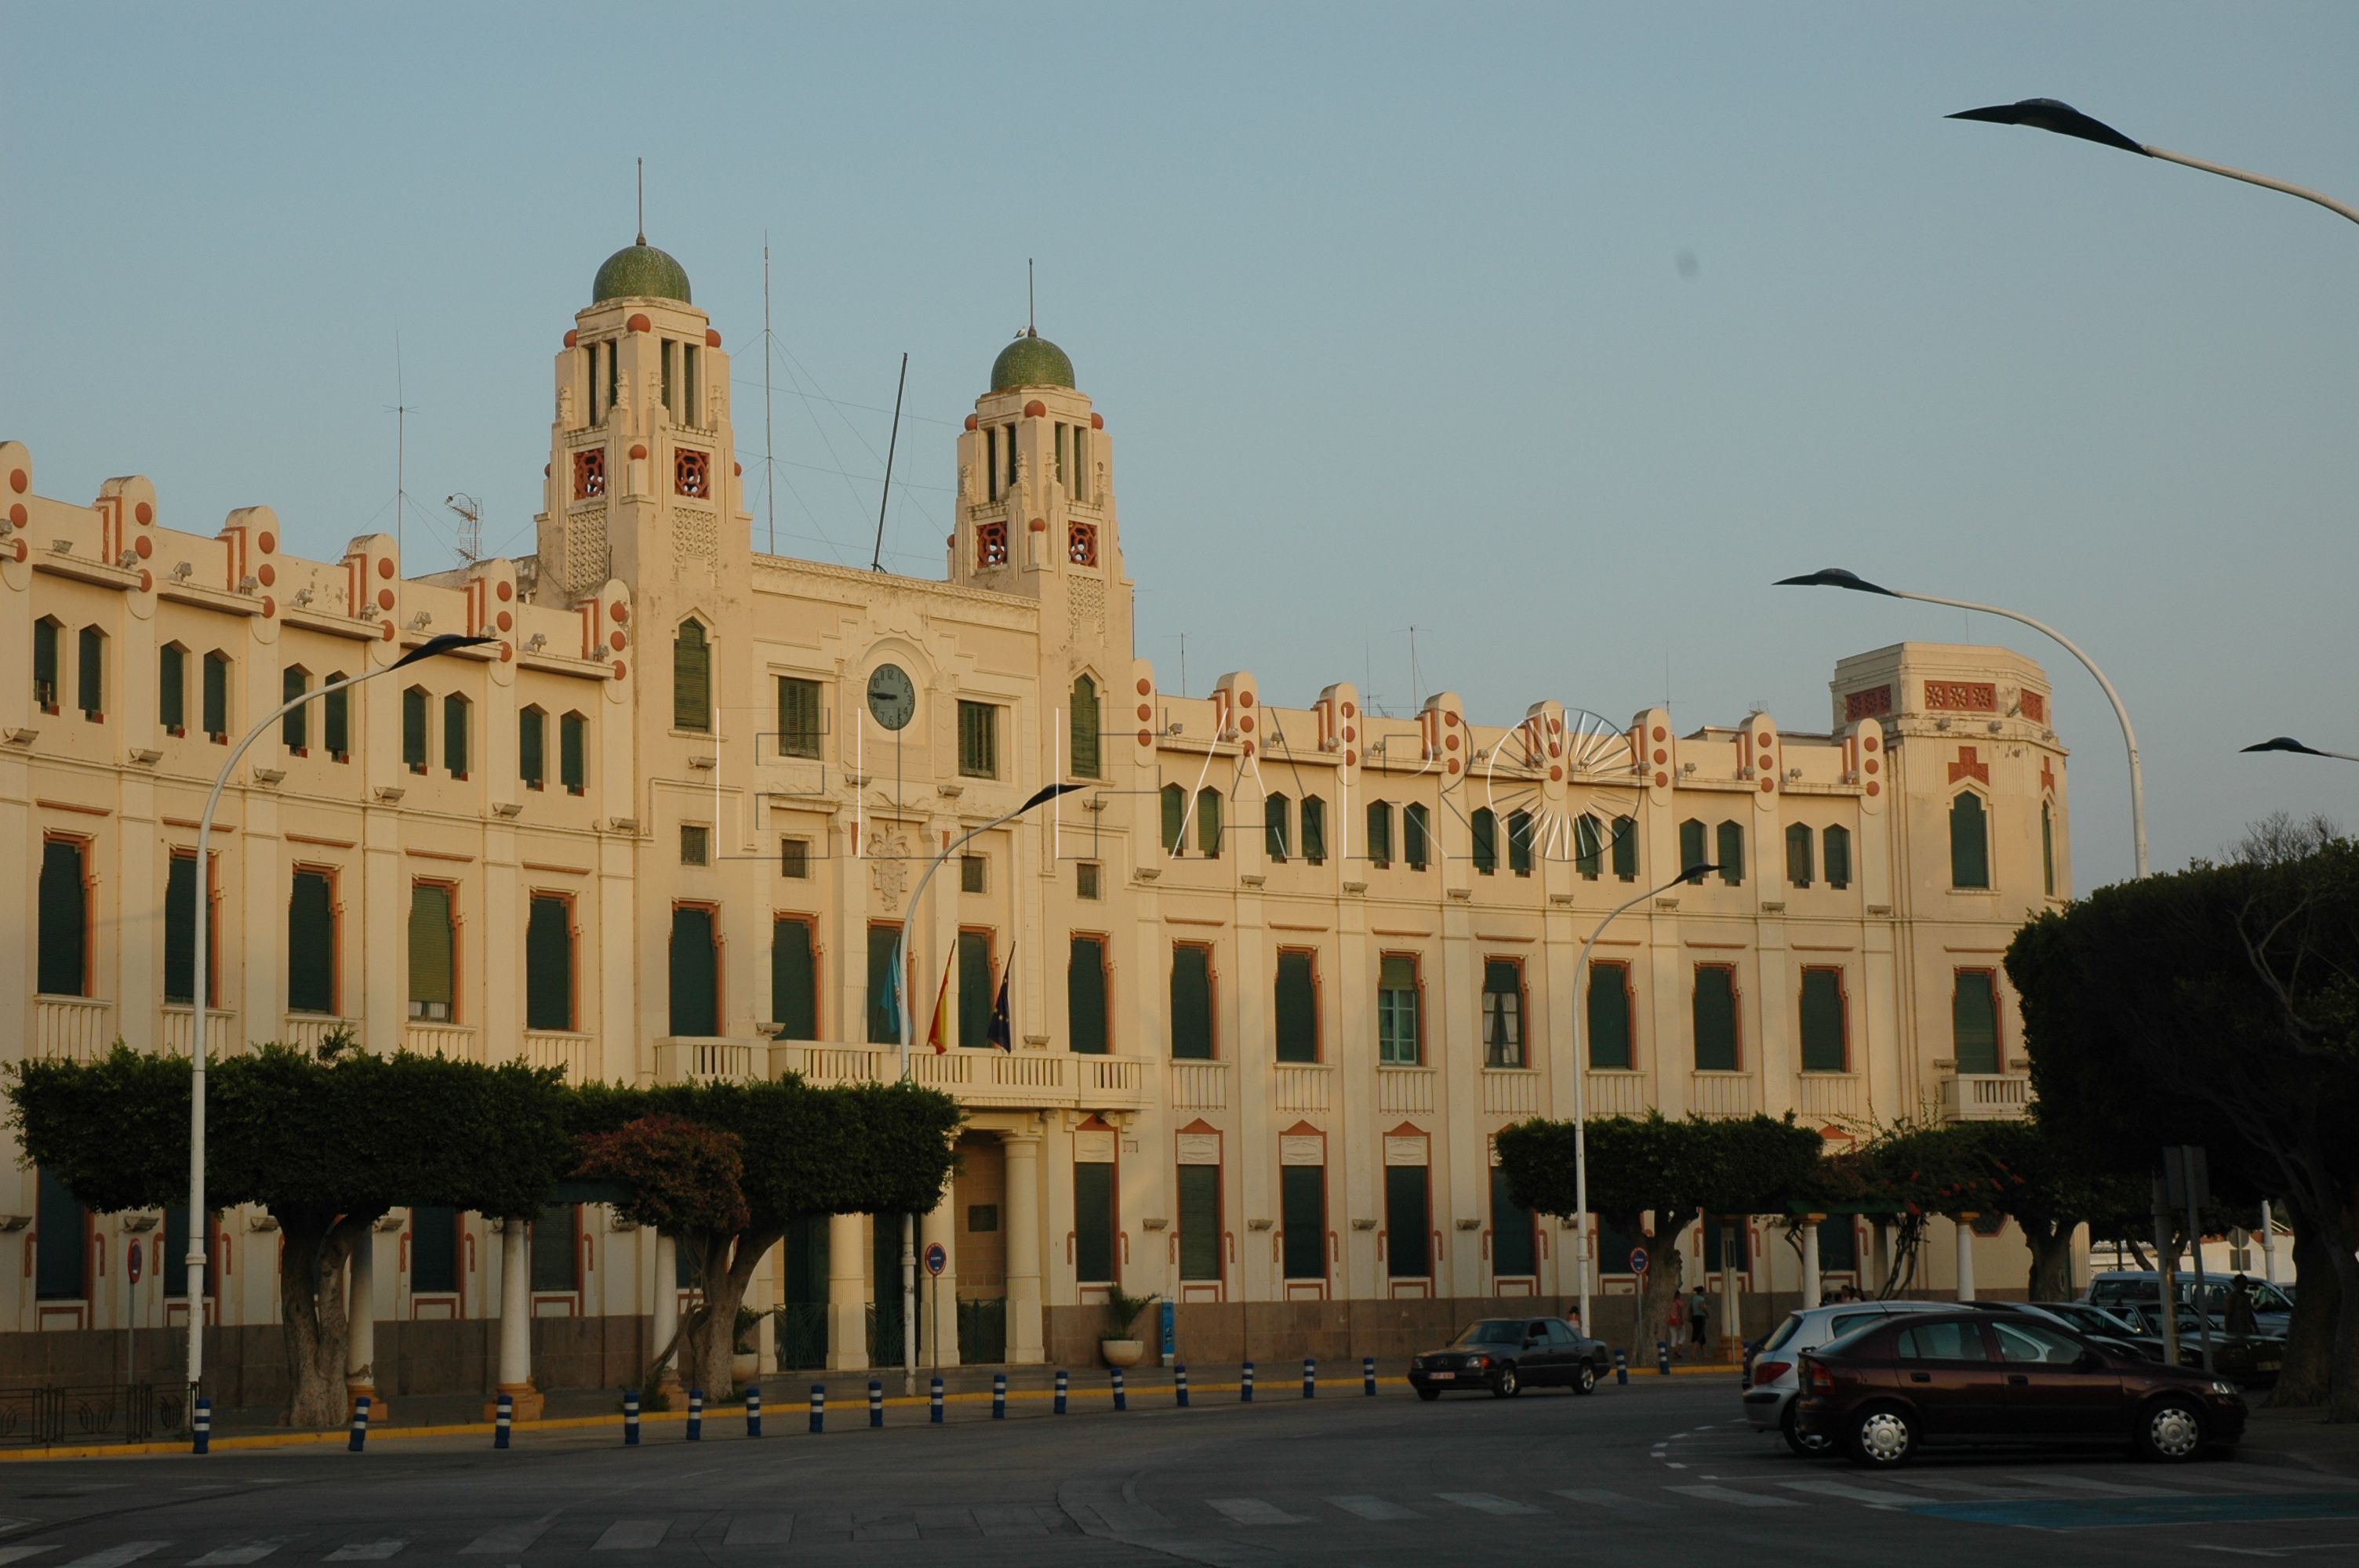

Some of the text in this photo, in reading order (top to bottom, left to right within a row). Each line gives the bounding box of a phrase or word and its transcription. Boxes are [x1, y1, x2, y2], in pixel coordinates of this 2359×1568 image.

[887, 669, 894, 680] 12
[873, 677, 880, 688] 10
[903, 682, 909, 693] 2
[907, 695, 912, 706] 3
[873, 702, 878, 713] 8
[903, 706, 908, 717] 4
[880, 711, 885, 722] 7
[889, 715, 893, 726] 6
